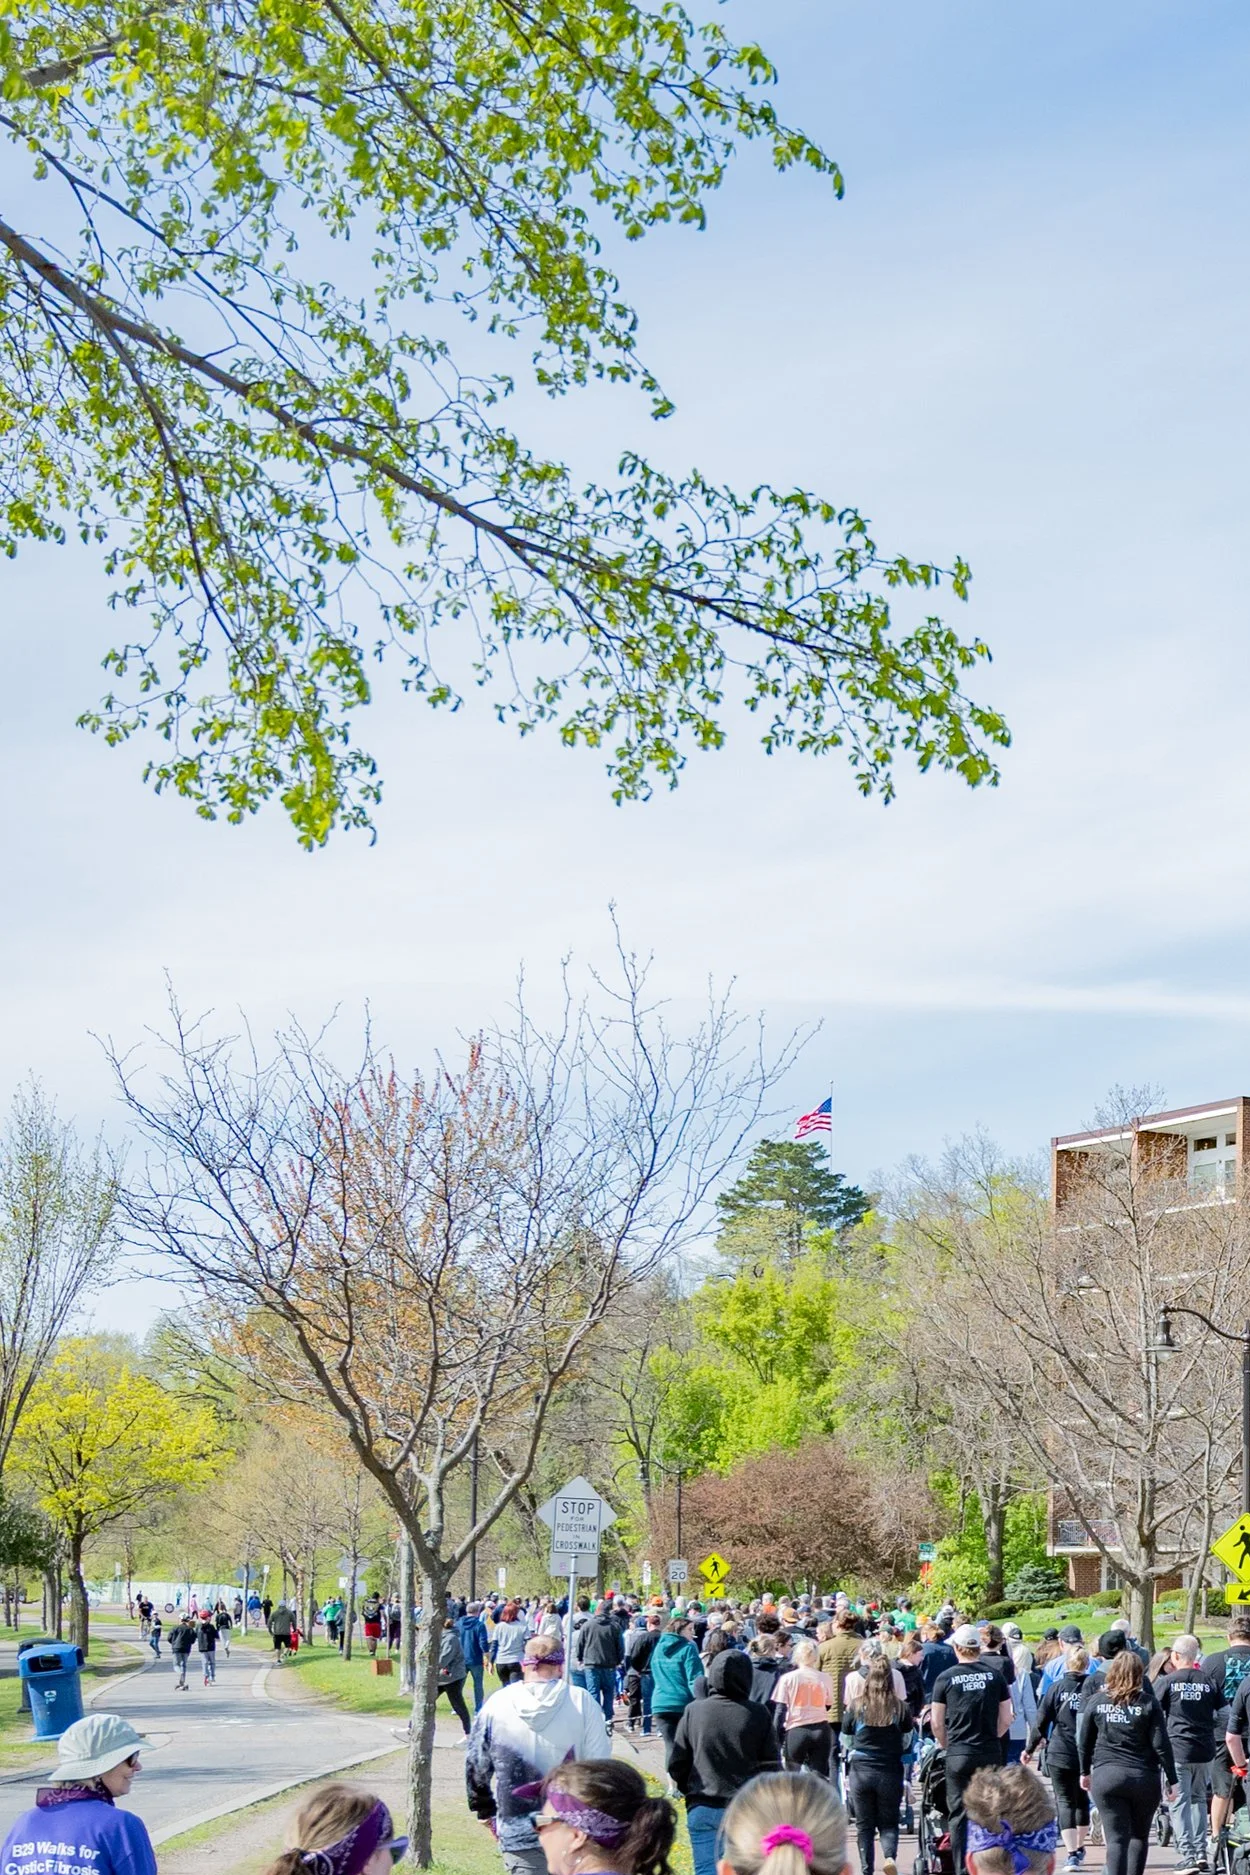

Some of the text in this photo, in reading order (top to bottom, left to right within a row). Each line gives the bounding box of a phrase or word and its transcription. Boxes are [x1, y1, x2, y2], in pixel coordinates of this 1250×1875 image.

[562, 1502, 594, 1514] STOP
[556, 1522, 597, 1532] PEDESTRIAN
[555, 1540, 596, 1550] CROSSWALK
[672, 1571, 686, 1579] 20
[952, 1672, 993, 1685] HUDSON'S
[962, 1681, 986, 1691] HERO
[1171, 1682, 1210, 1692] HUDSON'S
[1180, 1691, 1201, 1700] HERO
[1097, 1704, 1142, 1716] HUDSN'S
[12, 1841, 100, 1860] B29 Walks for
